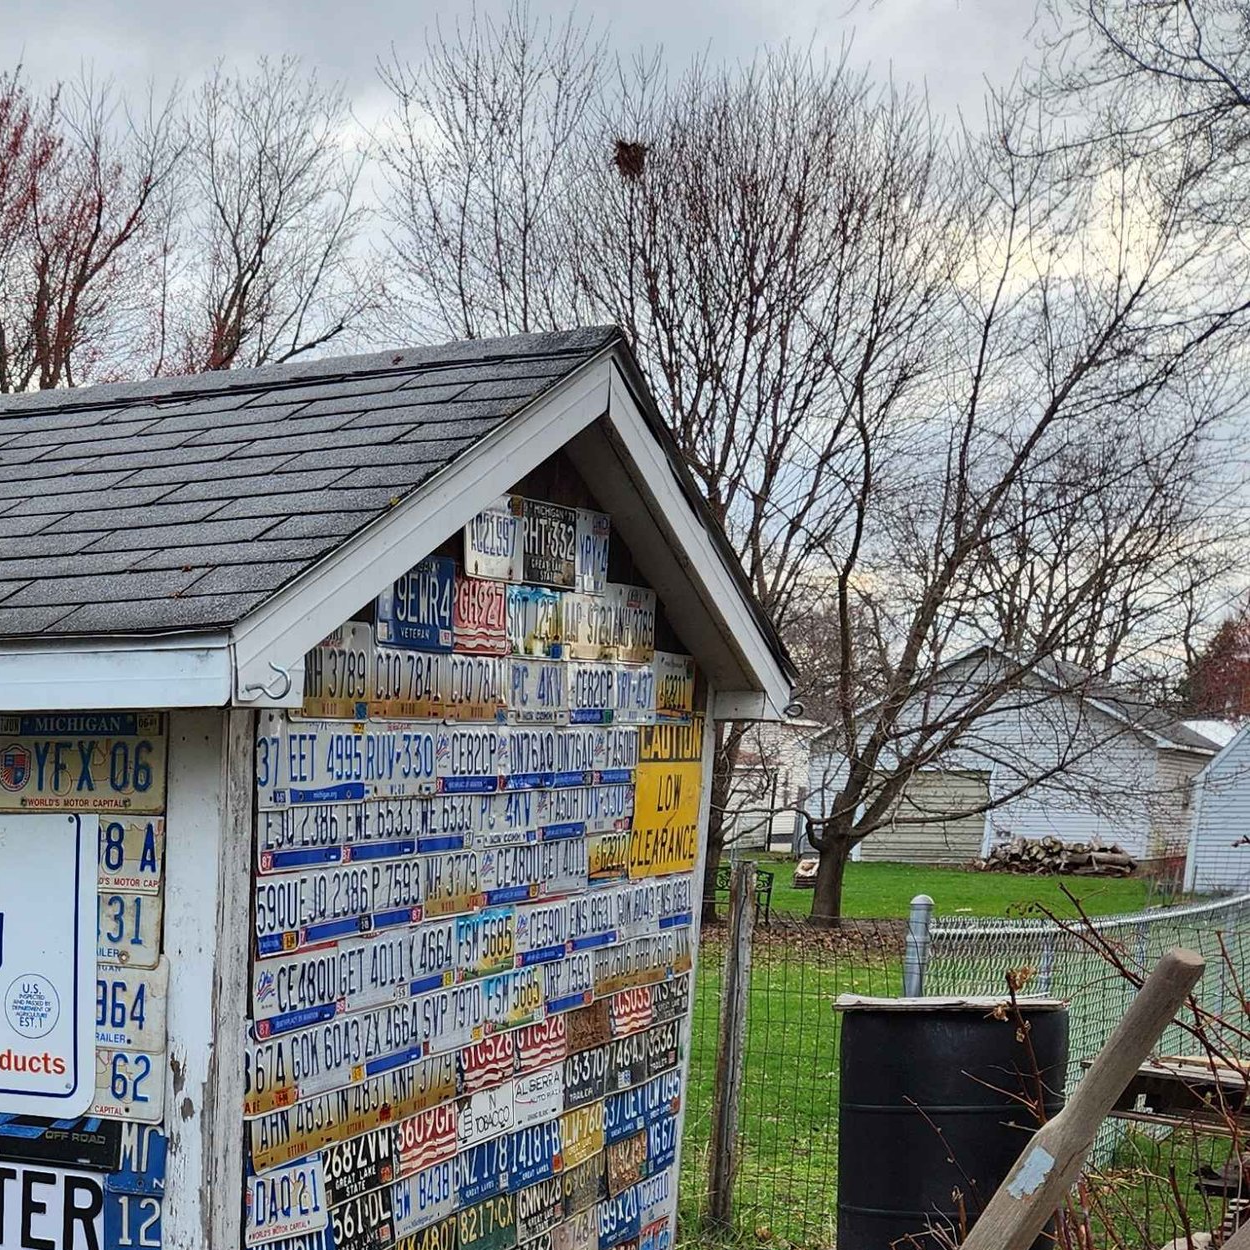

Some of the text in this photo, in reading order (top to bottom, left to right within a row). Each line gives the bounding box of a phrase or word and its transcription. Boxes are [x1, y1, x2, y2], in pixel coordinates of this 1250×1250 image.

[35, 717, 122, 732] MICHIGAN
[34, 740, 153, 792] YFX 06
[290, 733, 316, 782] EET
[27, 799, 125, 808] WORLD'S MOTOR CAPITAL
[657, 775, 682, 811] LOW
[631, 825, 696, 867] CLEARANCE
[333, 868, 368, 918] 2386
[23, 983, 41, 994] U.S.
[20, 1017, 37, 1028] EST.
[335, 1165, 376, 1190] GREAT LAKE
[346, 1182, 366, 1197] STATE
